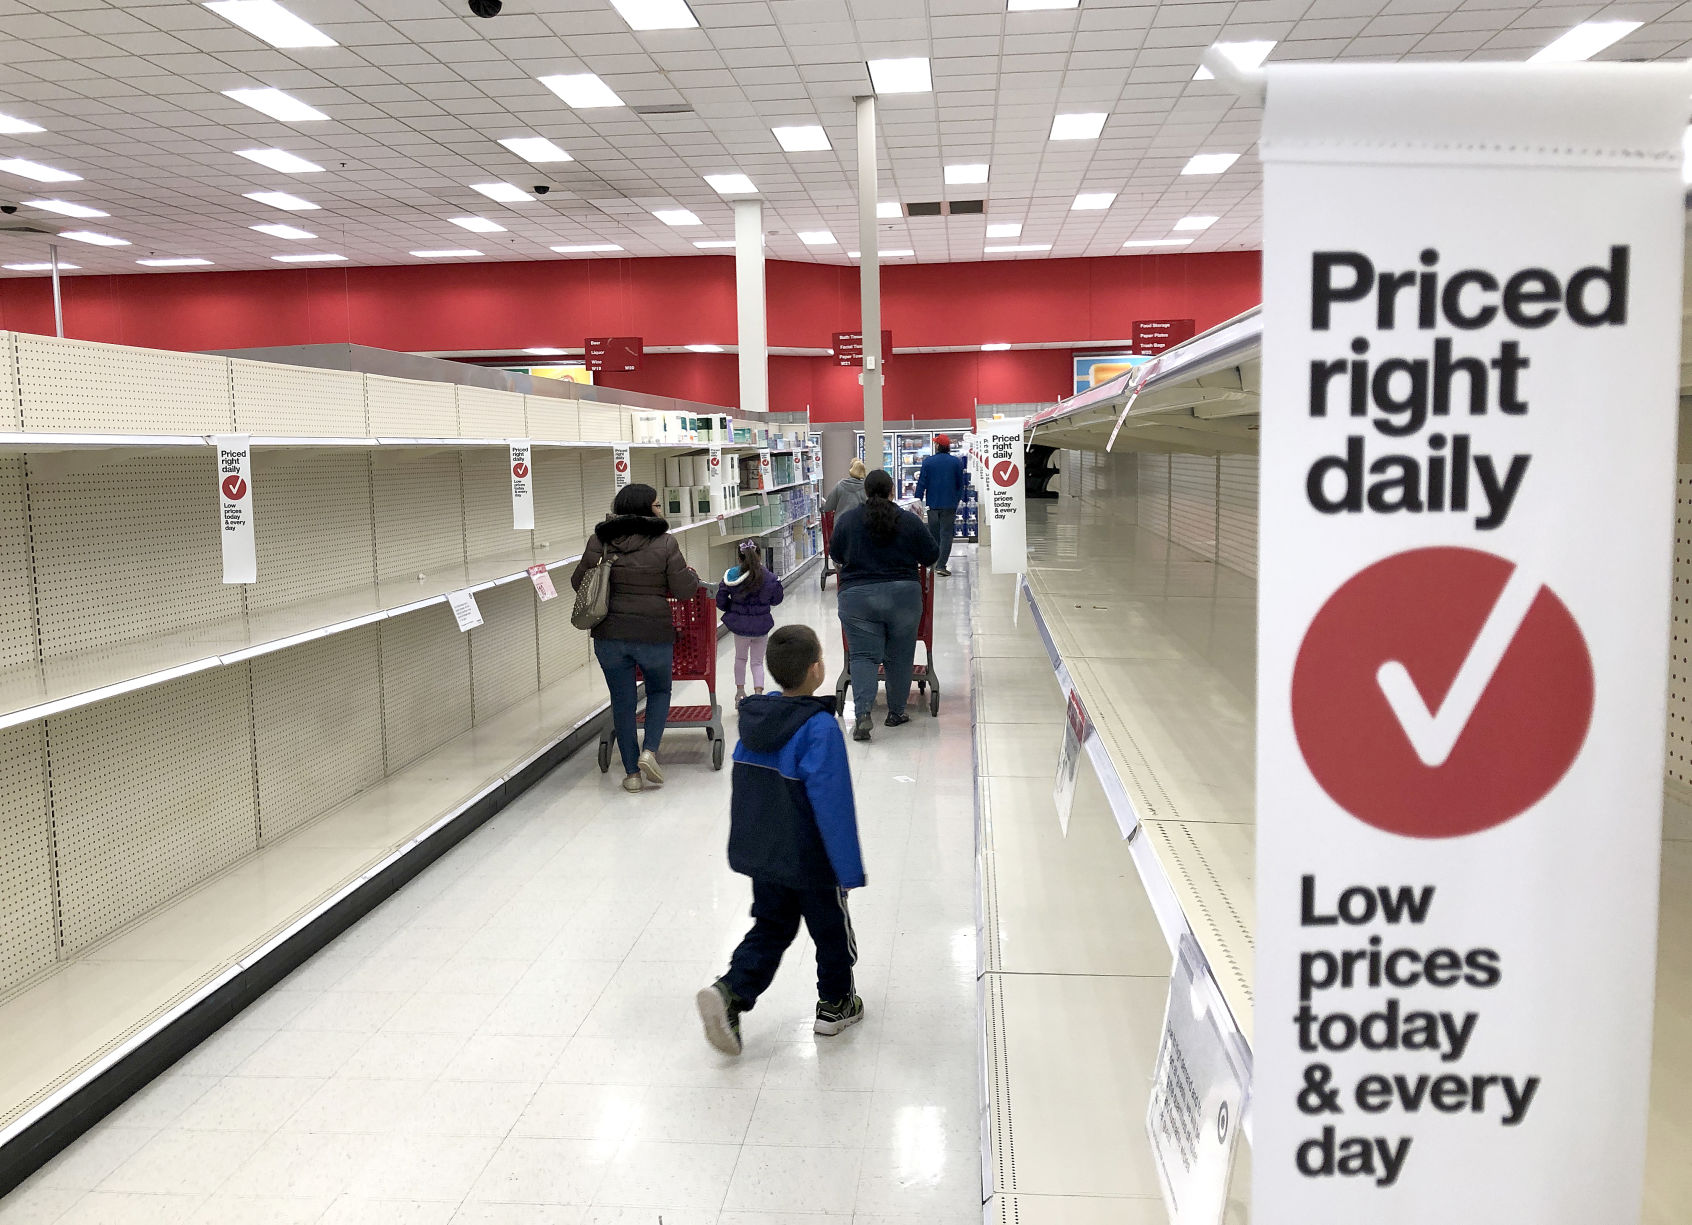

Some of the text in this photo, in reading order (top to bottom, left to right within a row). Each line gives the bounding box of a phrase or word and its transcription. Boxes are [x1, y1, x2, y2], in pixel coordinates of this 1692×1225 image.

[1310, 244, 1630, 330] Priced
[1308, 336, 1530, 437] right
[222, 458, 240, 466] right
[992, 434, 1020, 442] Priced
[992, 442, 1012, 452] right
[992, 450, 1013, 460] daily
[222, 466, 240, 474] daily
[1306, 433, 1532, 531] daily
[1300, 874, 1436, 926] Low
[1299, 934, 1502, 1002] prices
[1293, 998, 1479, 1062] today
[1295, 1062, 1541, 1126] & every
[1295, 1125, 1413, 1187] day
